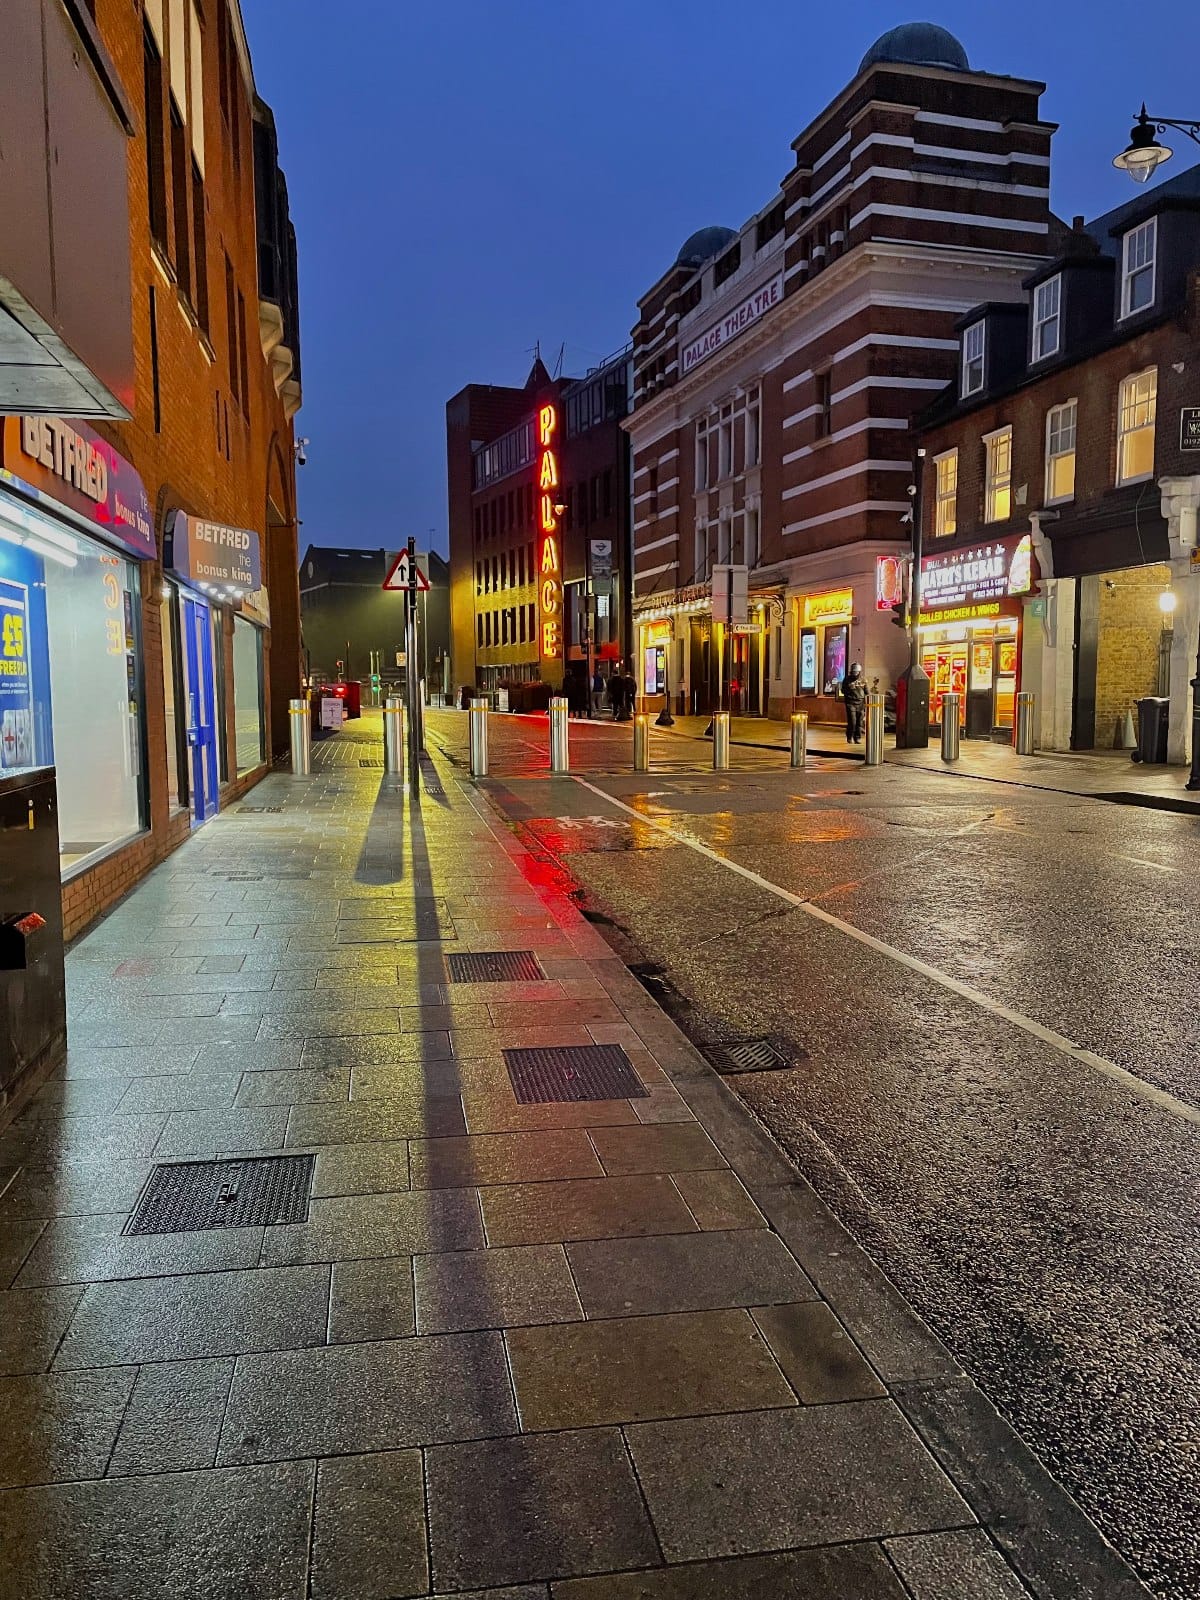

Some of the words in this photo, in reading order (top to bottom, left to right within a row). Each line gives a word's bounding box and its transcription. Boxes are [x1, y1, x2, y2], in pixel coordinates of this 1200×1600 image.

[686, 326, 721, 367] PALACE
[724, 281, 778, 337] THEATRE
[22, 415, 108, 503] BETFRED
[114, 492, 136, 527] bonus
[137, 509, 150, 542] king
[539, 404, 557, 658] PALACE
[195, 521, 250, 550] BETFRED
[196, 559, 228, 578] bonus
[231, 566, 252, 585] king
[239, 553, 251, 567] the
[964, 557, 1003, 580] KEBAB
[943, 607, 970, 620] CHICKEN
[971, 606, 976, 617] &
